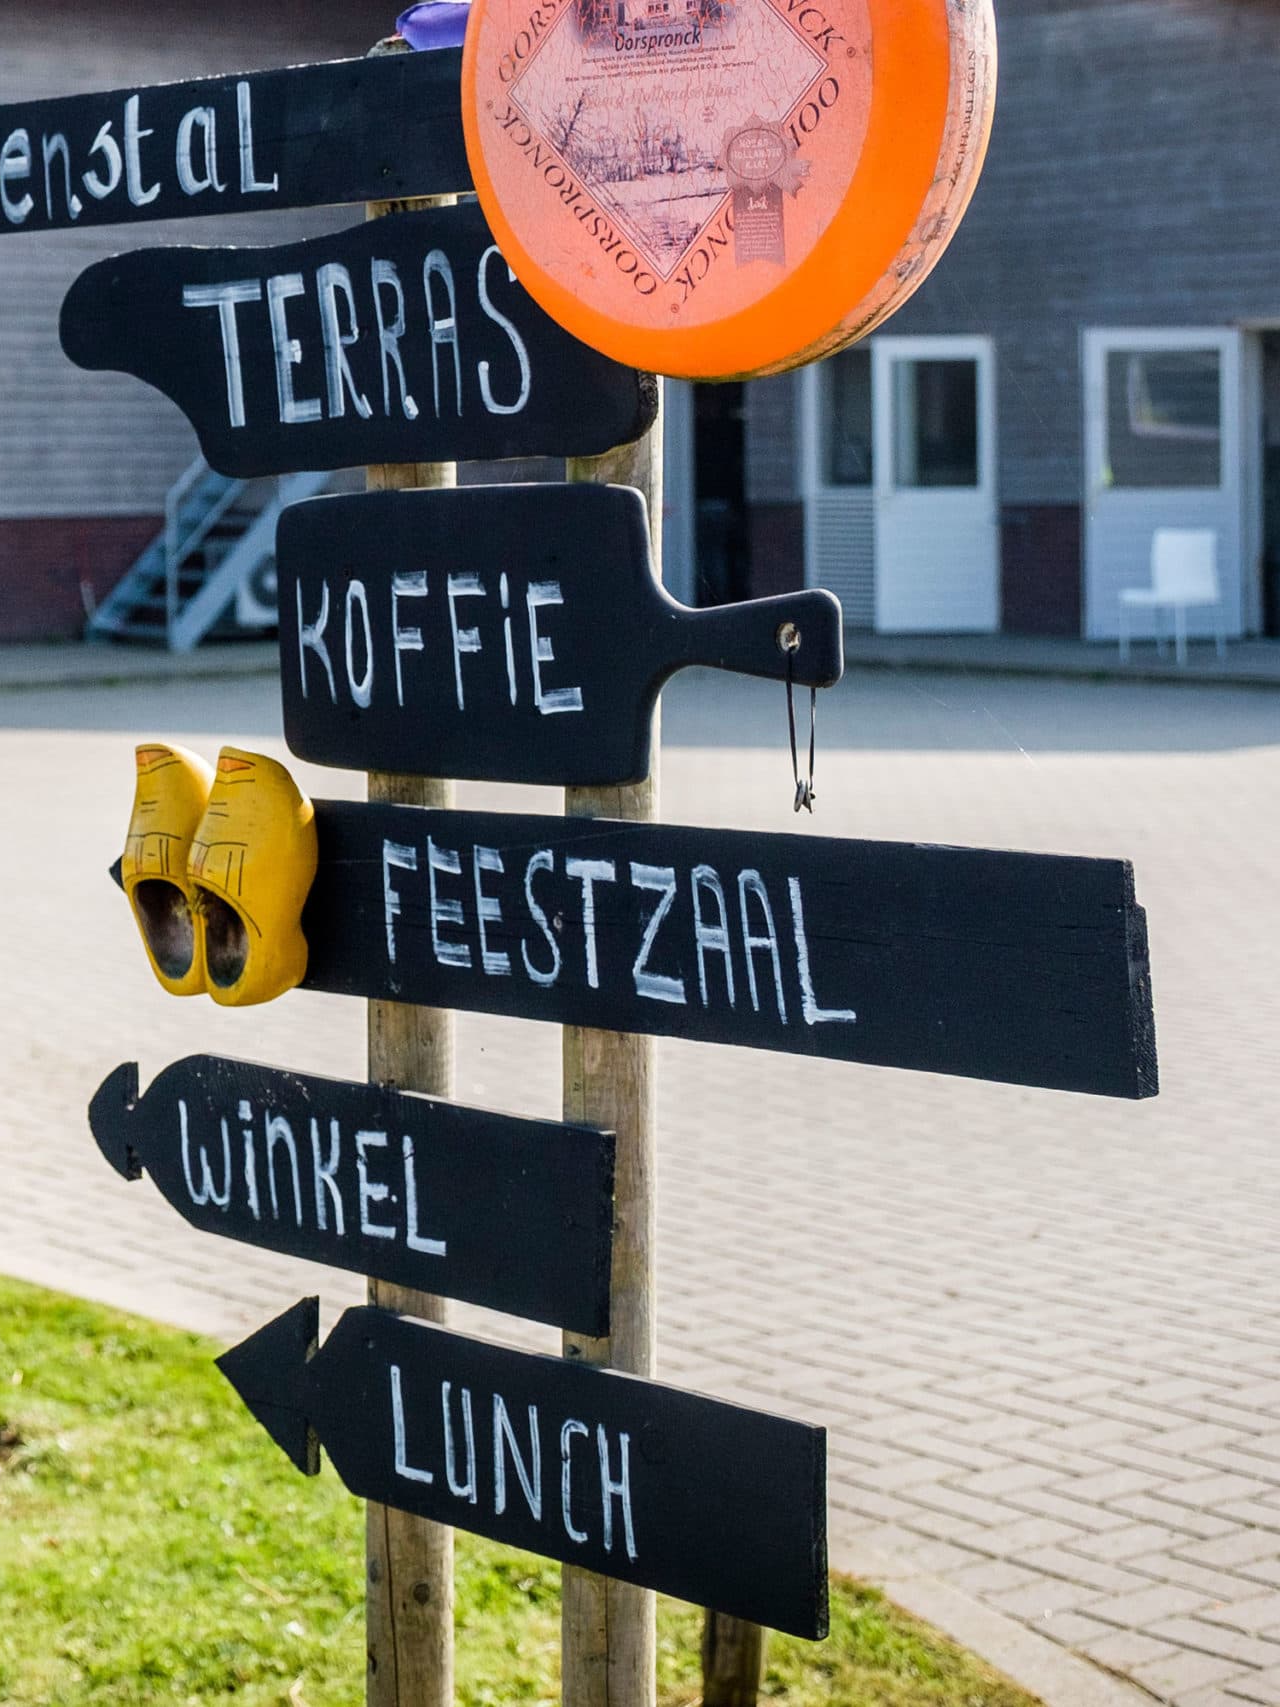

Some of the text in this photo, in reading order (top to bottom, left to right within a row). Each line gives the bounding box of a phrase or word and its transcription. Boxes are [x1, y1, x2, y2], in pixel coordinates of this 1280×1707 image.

[499, 0, 562, 83] OORS
[614, 24, 702, 53] Oorspronck
[495, 106, 657, 295] OORSPRONCK
[183, 244, 531, 427] TERRAS
[382, 834, 857, 1026] FEESTZAAL
[390, 1364, 639, 1563] LUNCH
